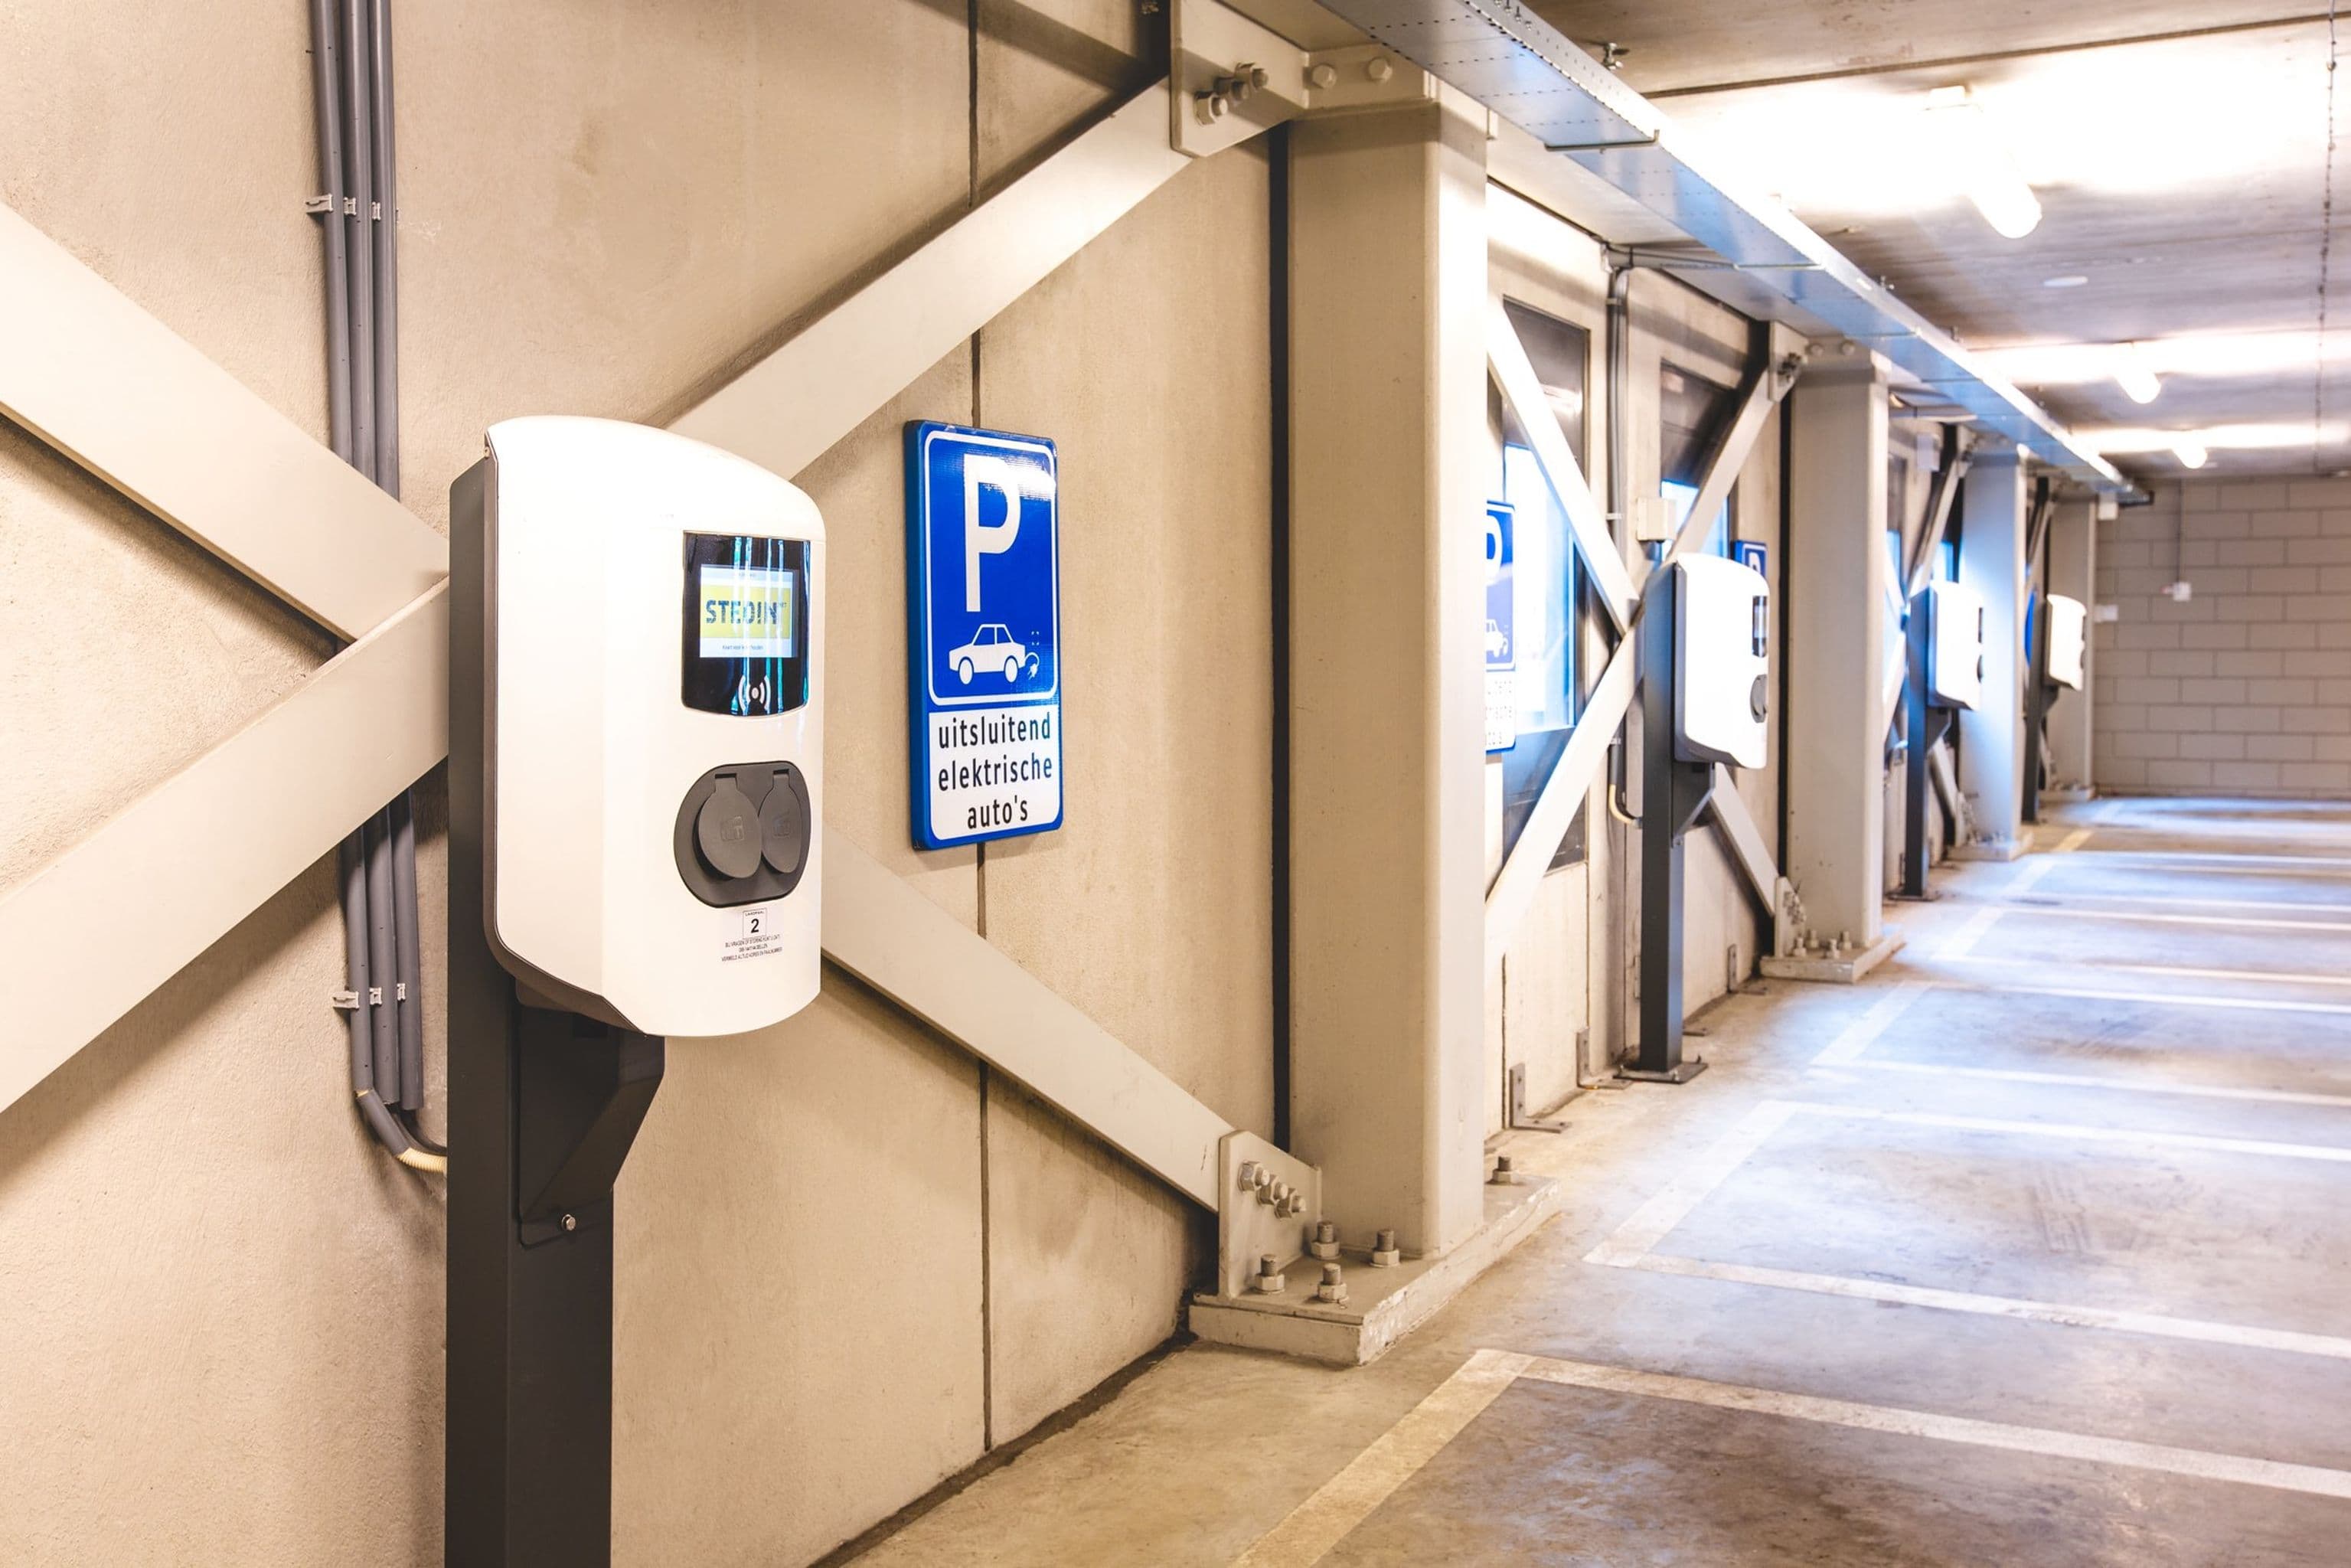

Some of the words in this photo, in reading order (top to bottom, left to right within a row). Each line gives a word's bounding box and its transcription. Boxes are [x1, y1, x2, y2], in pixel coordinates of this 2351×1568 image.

[964, 453, 1020, 612] P
[705, 599, 778, 626] STEDIN
[939, 711, 1050, 749] uitsluitend
[939, 752, 1052, 791] elektrische
[967, 795, 1028, 830] auto's
[750, 918, 759, 933] 2
